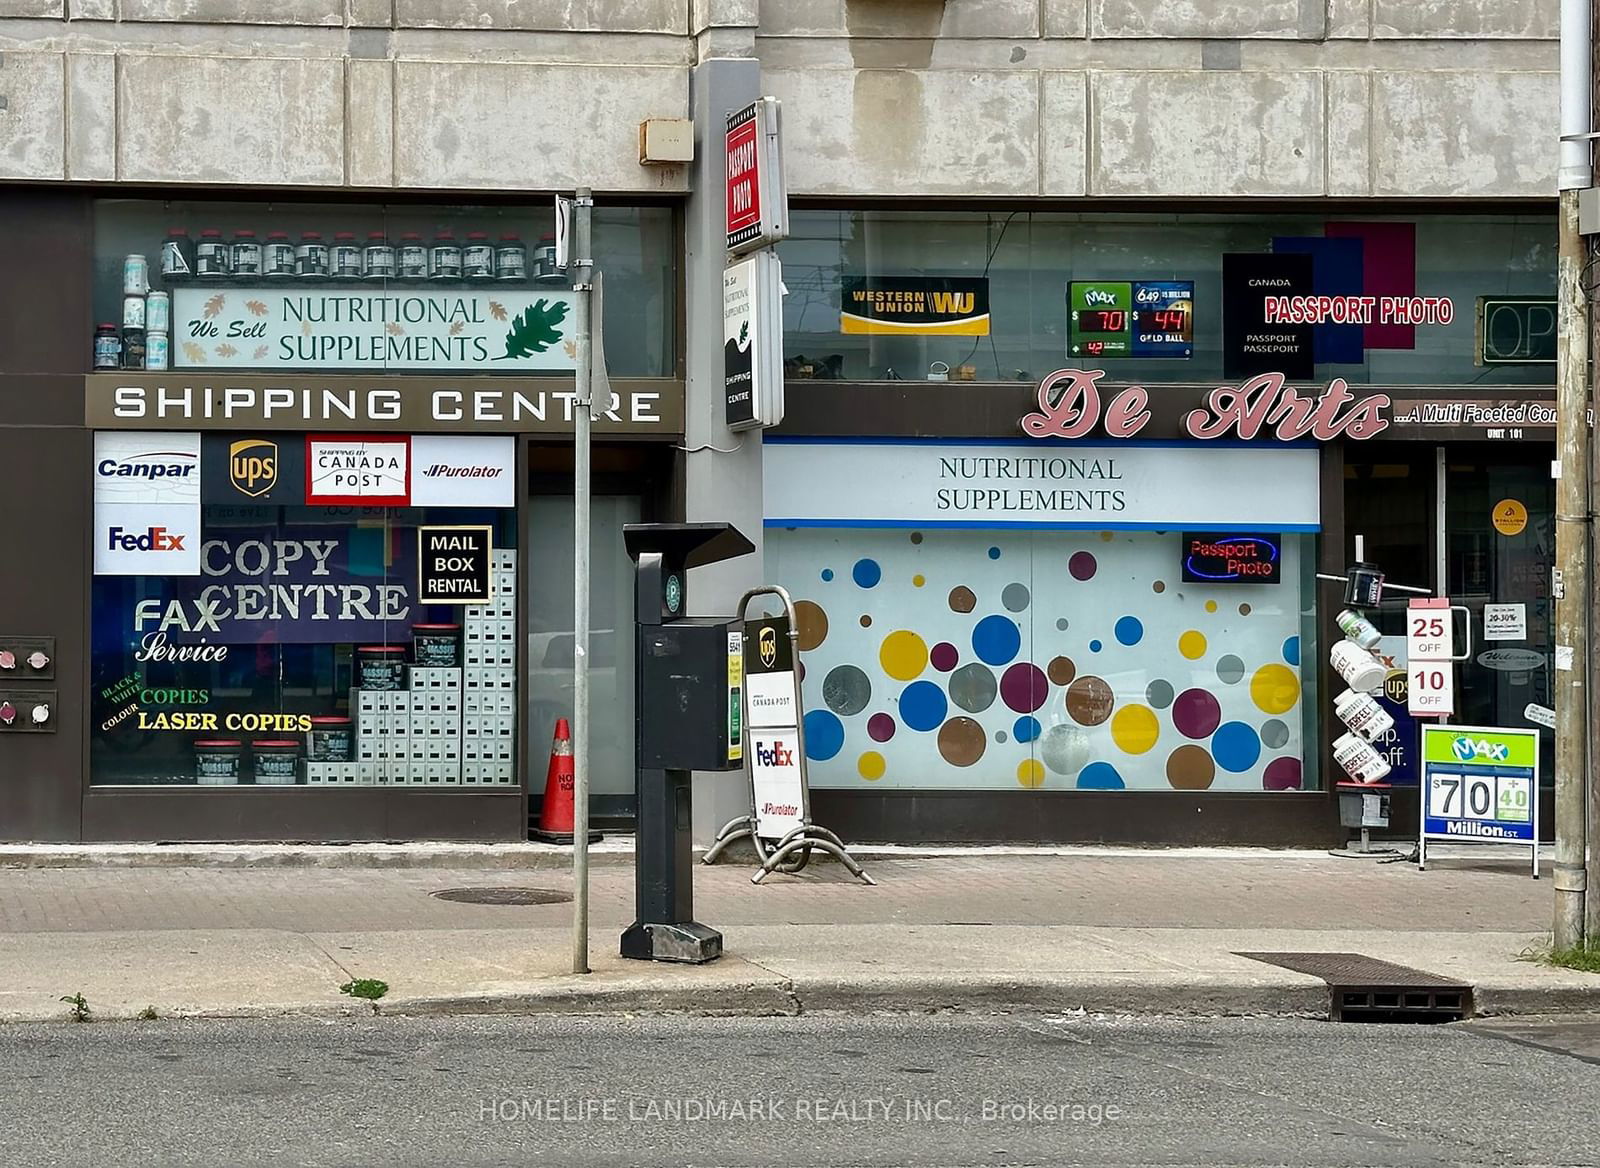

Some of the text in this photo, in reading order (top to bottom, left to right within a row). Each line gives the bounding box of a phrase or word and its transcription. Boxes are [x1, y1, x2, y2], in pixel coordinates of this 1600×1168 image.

[728, 140, 755, 180] PASSPORT
[733, 178, 752, 214] PHOTO
[1248, 279, 1291, 287] CANADA
[853, 291, 924, 302] WESTERN
[933, 292, 975, 314] WU
[283, 297, 485, 324] NUTRITIONAL
[875, 302, 924, 313] UNION
[1264, 296, 1455, 325] PASSPORT PHOTO
[188, 319, 268, 338] We Sell
[1155, 311, 1184, 330] 44
[1165, 334, 1184, 342] BALL
[1246, 334, 1297, 342] PASSPORT
[279, 335, 488, 362] SUPPLEMENTS
[726, 371, 751, 386] SHIPPING
[113, 387, 660, 422] SHIPPING CENTRE
[728, 391, 750, 404] CENTRE
[1021, 368, 1391, 441] De Arts
[1422, 403, 1462, 423] Multi
[1463, 403, 1526, 424] Faceted
[1487, 429, 1523, 438] UNIT 101
[98, 459, 196, 480] Canpar
[318, 456, 399, 469] CANADA
[436, 465, 503, 477] Purolator
[938, 457, 1122, 480] NUTRITIONAL
[233, 457, 275, 488] ups
[335, 474, 382, 487] POST
[937, 489, 1126, 511] SUPPLEMENTS
[109, 527, 186, 551] FedEx
[431, 536, 479, 550] MAIL
[201, 540, 339, 577] COPY
[1191, 540, 1258, 559] Passport
[435, 557, 475, 572] BOX
[1227, 559, 1273, 575] Photo
[428, 579, 482, 593] RENTAL
[200, 585, 410, 621] CENTRE
[135, 600, 221, 632] FAX
[1413, 618, 1444, 637] 25
[135, 632, 228, 662] Service
[760, 640, 776, 662] ups
[1419, 643, 1441, 652] OFF
[102, 671, 142, 699] BLACK &
[1414, 670, 1444, 690] 10
[111, 682, 144, 704] WHITE
[141, 689, 209, 704] COPIES
[753, 697, 790, 707] CANADA POST
[1419, 696, 1441, 705] OFF
[102, 703, 139, 731] COLOUR
[138, 712, 312, 731] LASER COPIES
[756, 741, 794, 767] FedEx
[1452, 737, 1505, 761] MAX
[768, 803, 798, 816] Purolator
[1447, 821, 1504, 838] Million
